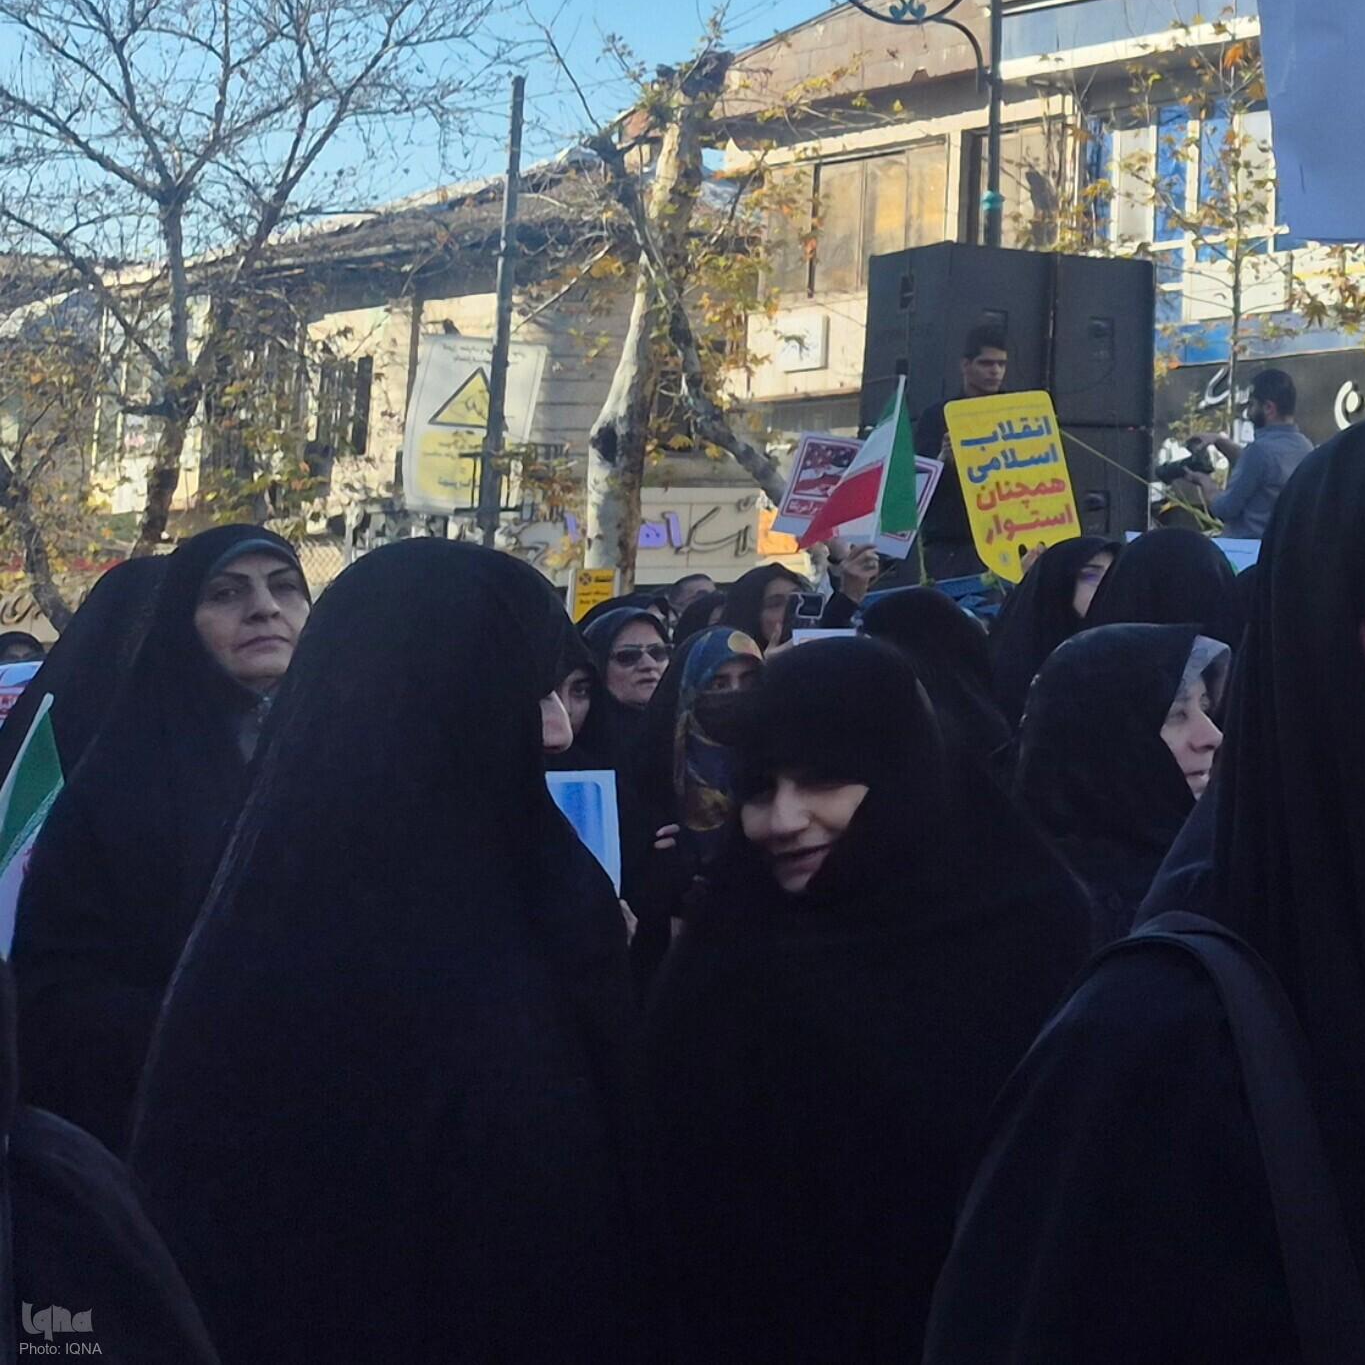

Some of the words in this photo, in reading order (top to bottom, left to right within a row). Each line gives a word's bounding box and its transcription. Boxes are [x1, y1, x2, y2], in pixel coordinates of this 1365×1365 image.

[960, 415, 1054, 452] انقلاب
[967, 442, 1060, 484] اسلامی
[976, 477, 1067, 512] همچنان
[985, 503, 1074, 546] استوار
